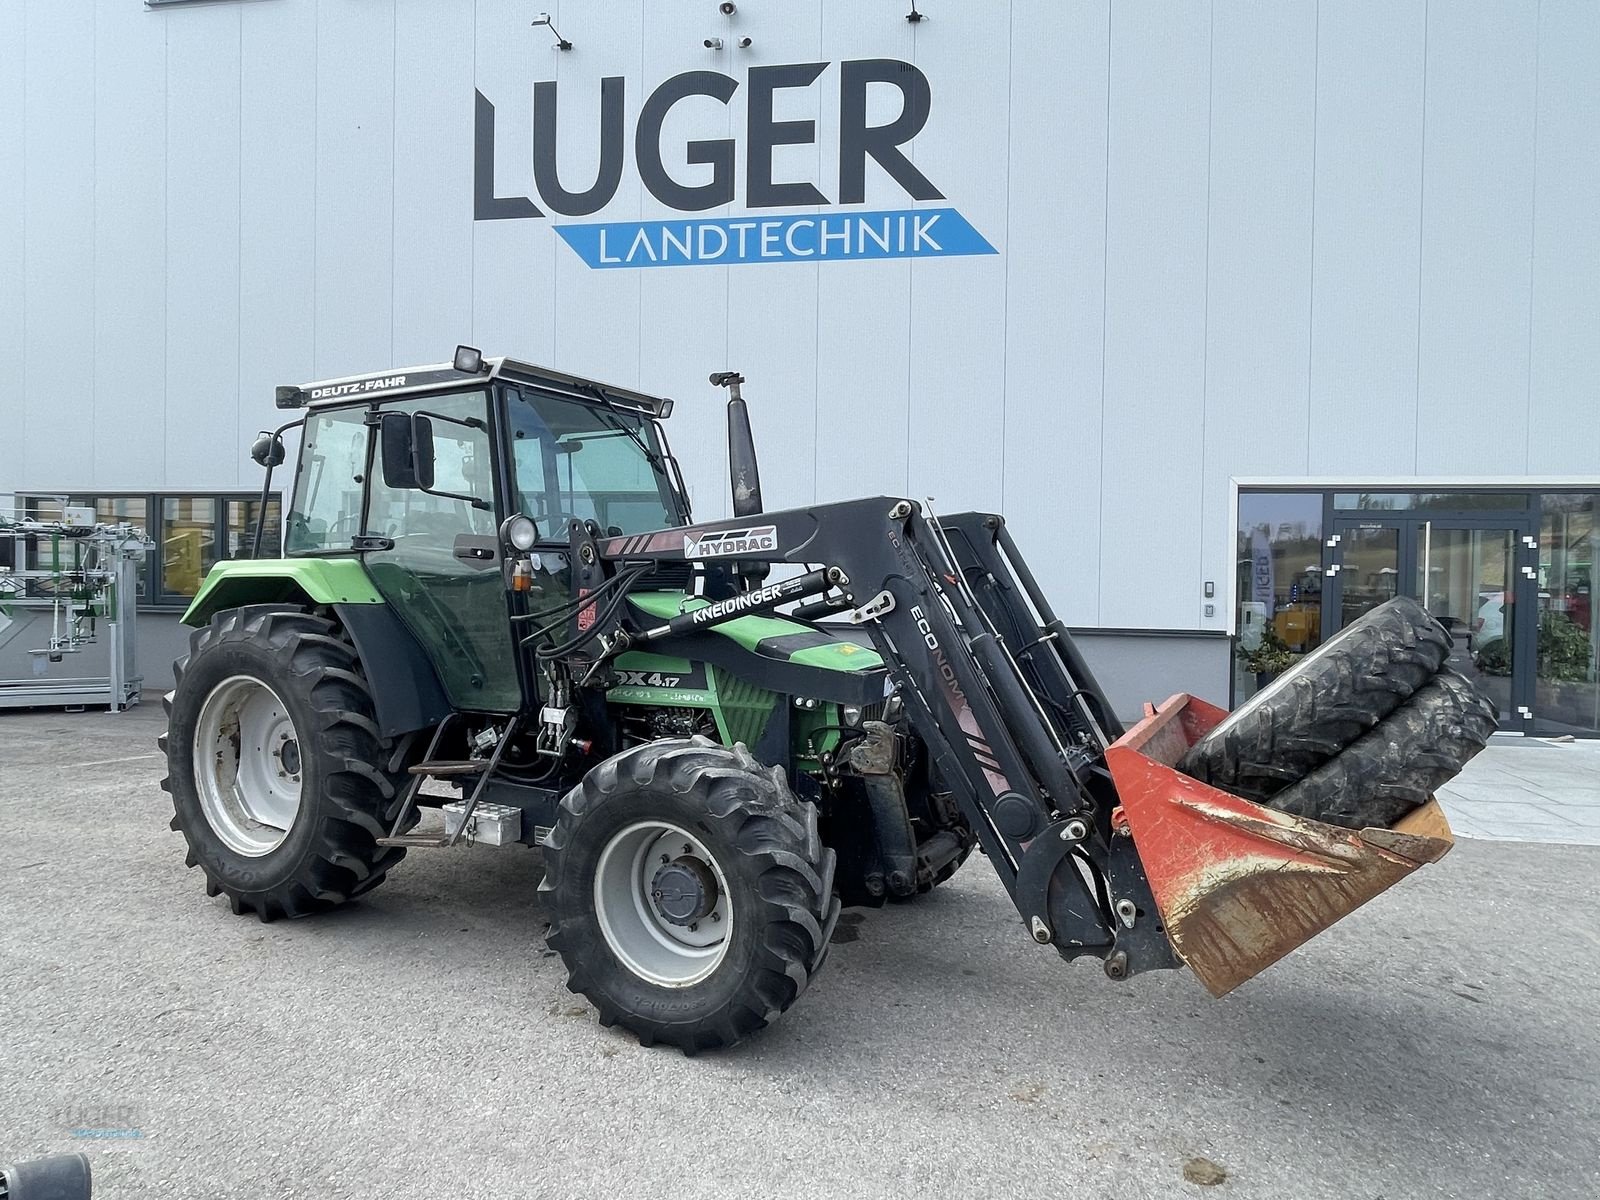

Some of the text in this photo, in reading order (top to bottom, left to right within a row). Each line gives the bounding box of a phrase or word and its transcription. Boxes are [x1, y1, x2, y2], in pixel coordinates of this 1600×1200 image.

[474, 58, 947, 220] LUGER
[599, 214, 944, 264] LANDTECHNIK
[311, 375, 407, 399] DEUTZ-FAHR
[699, 537, 773, 556] HYDRAC
[692, 583, 783, 624] KNEIDINGER
[647, 672, 681, 688] 4.17
